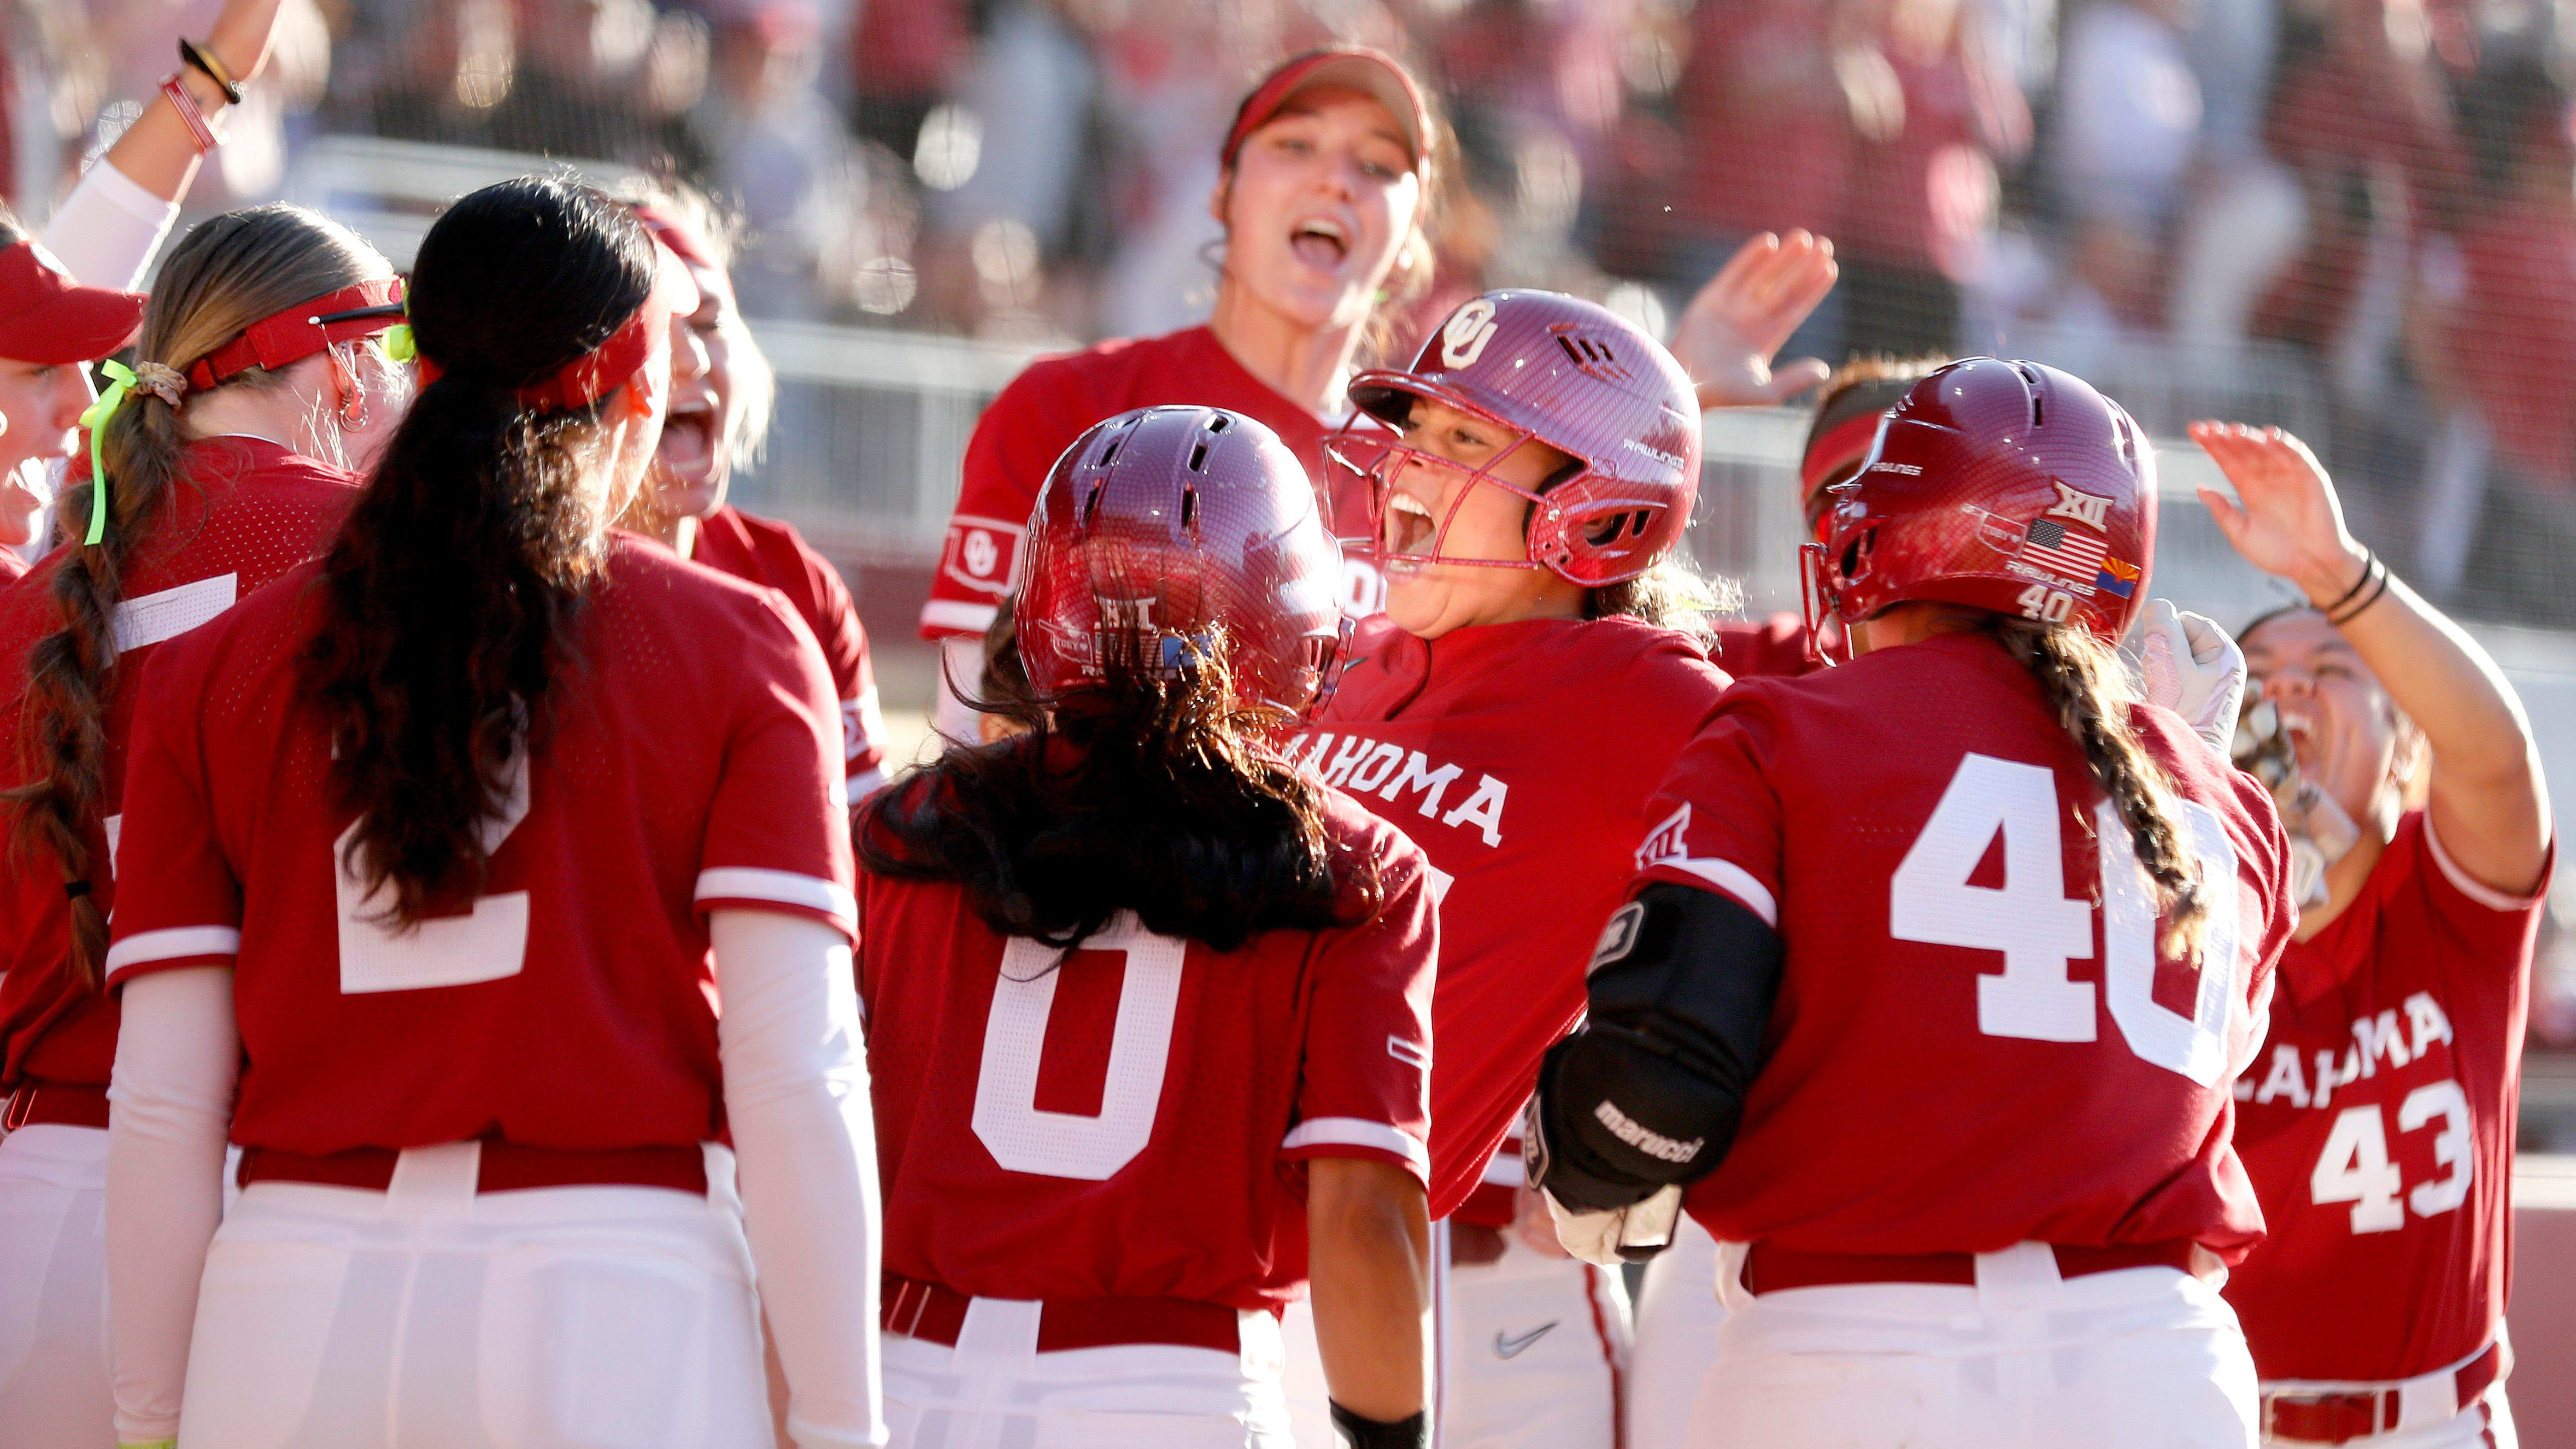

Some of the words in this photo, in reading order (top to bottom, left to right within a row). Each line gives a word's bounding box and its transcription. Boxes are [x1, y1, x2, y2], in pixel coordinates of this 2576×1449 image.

[1442, 299, 1499, 370] OU
[2016, 584, 2074, 624] 40
[1890, 752, 2239, 1089] 40
[971, 907, 1187, 1192] 0
[1594, 1099, 1705, 1163] marucci
[2310, 1078, 2474, 1235] 43
